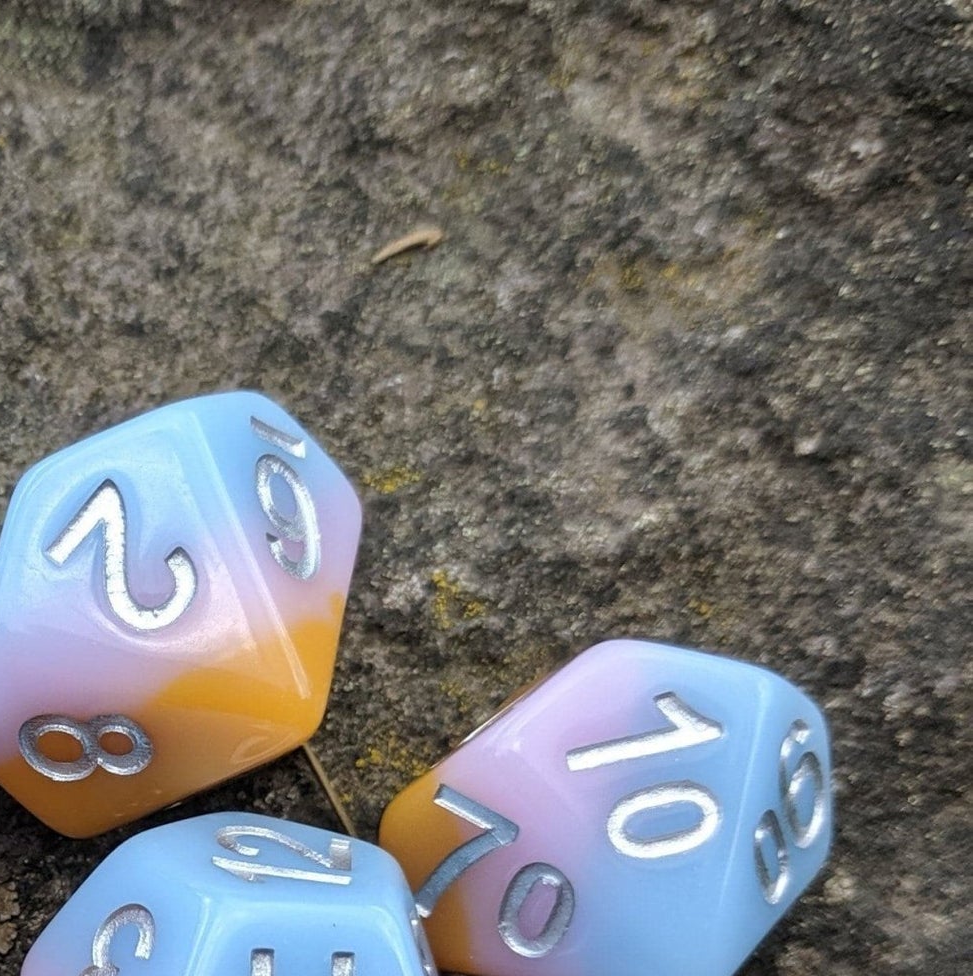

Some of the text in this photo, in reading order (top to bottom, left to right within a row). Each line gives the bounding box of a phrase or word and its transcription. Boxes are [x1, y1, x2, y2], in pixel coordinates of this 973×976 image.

[45, 478, 198, 632] 2
[18, 713, 154, 782] 8
[566, 691, 724, 859] 10
[211, 824, 353, 886] 12
[412, 783, 576, 959] 70
